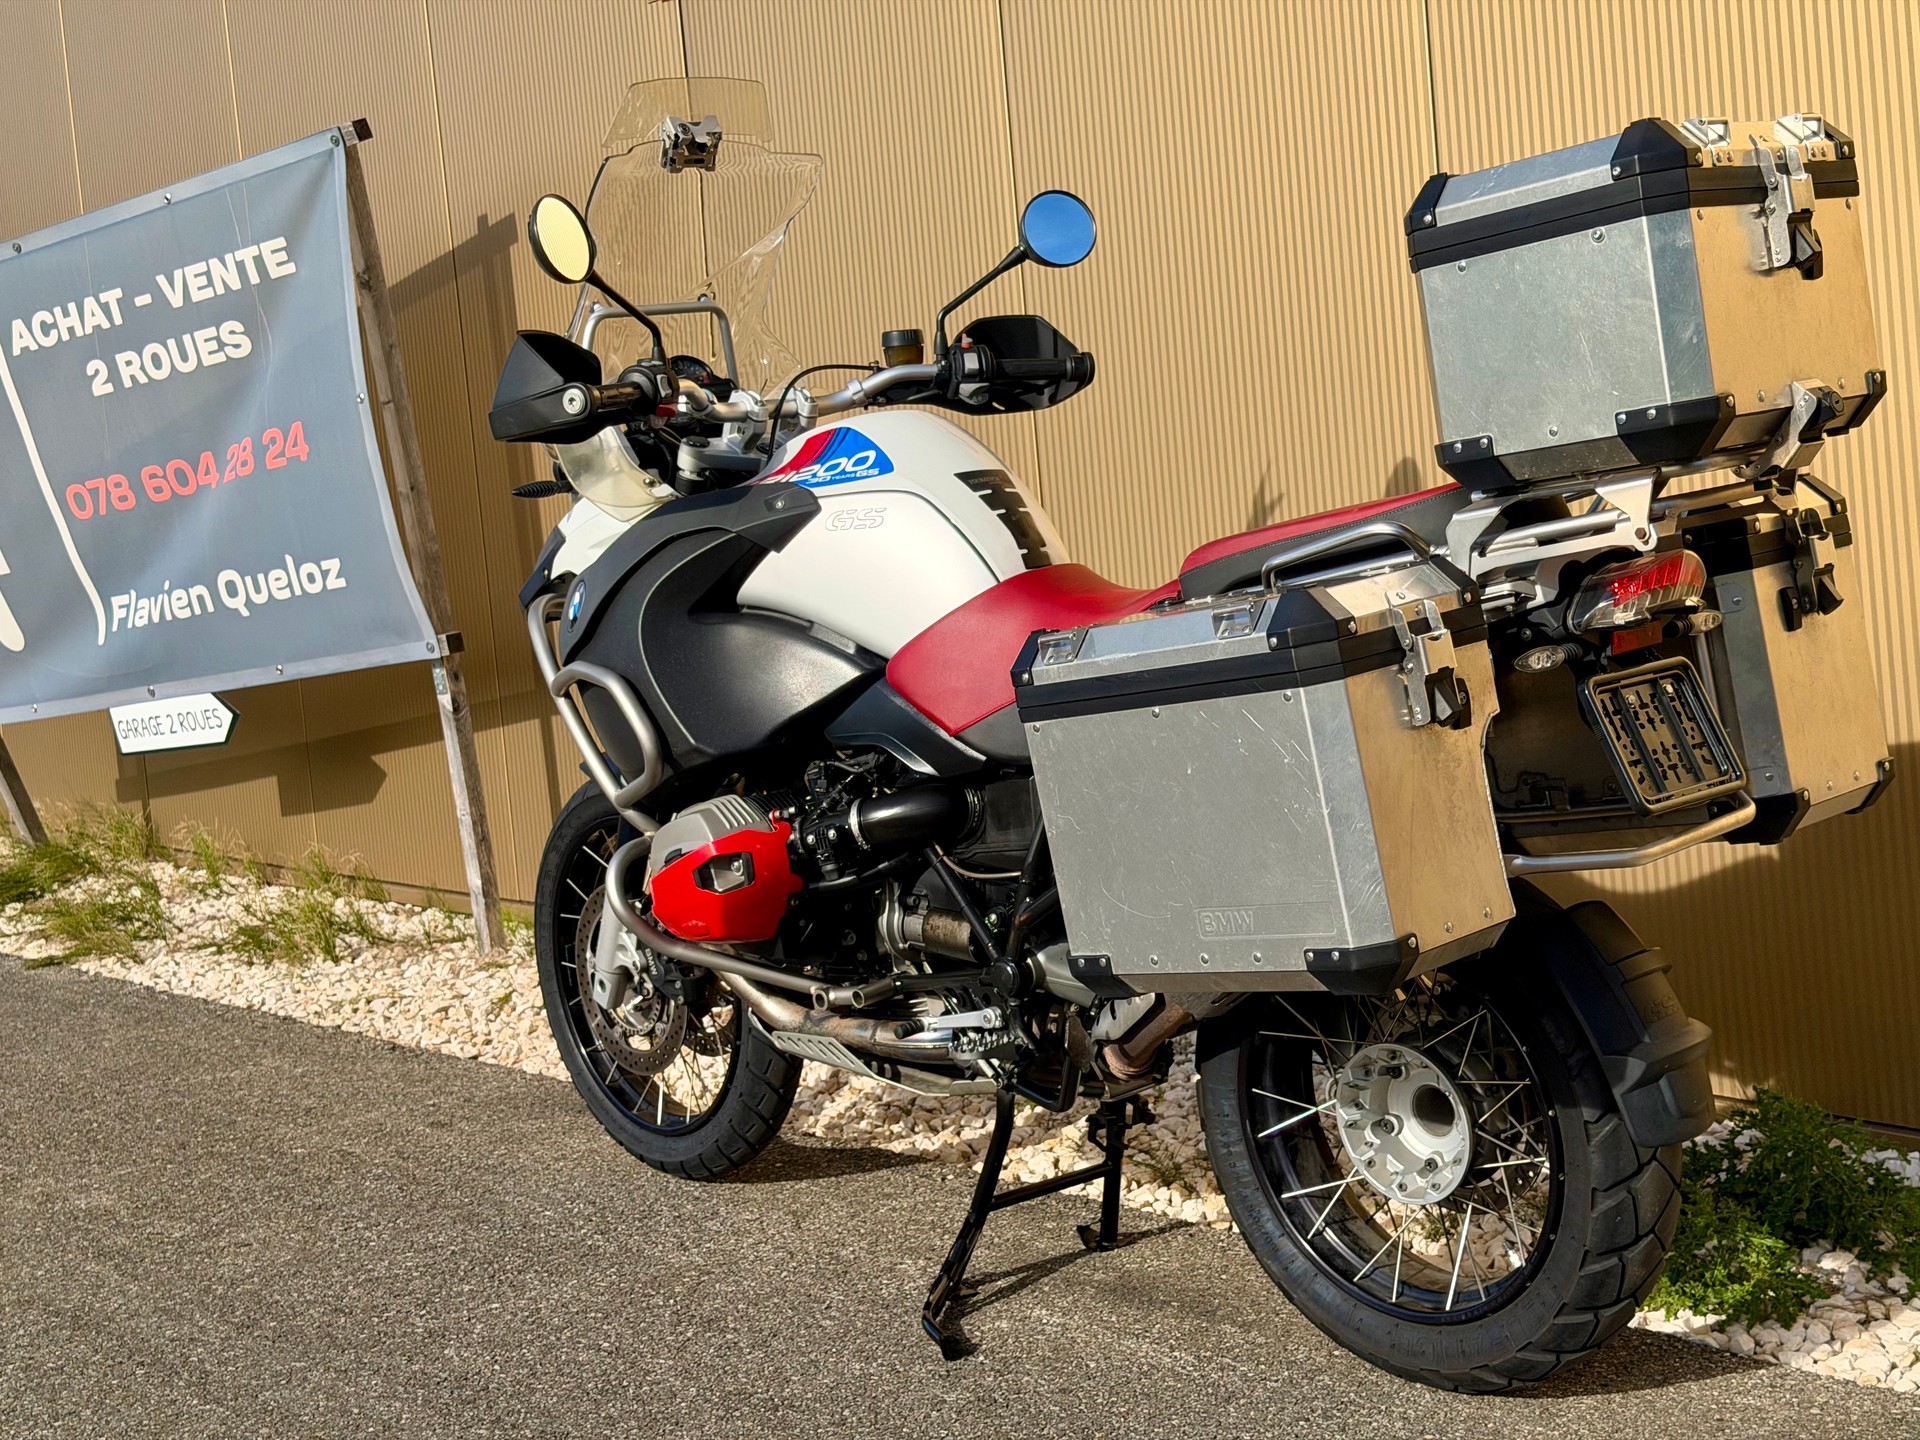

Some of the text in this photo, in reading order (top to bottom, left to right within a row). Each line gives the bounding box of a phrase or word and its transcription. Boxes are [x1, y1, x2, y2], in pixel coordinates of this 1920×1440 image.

[11, 236, 297, 357] ACHAT - VENTE
[86, 320, 253, 397] 2 ROUES
[65, 421, 310, 520] 078 604 28 24
[806, 467, 880, 484] 30 YEARS GS
[825, 507, 887, 531] GS
[110, 553, 347, 633] Flavien Queloz
[117, 708, 223, 740] GARAGE 2 ROUES
[1200, 910, 1253, 935] BMW
[645, 948, 658, 975] BMW
